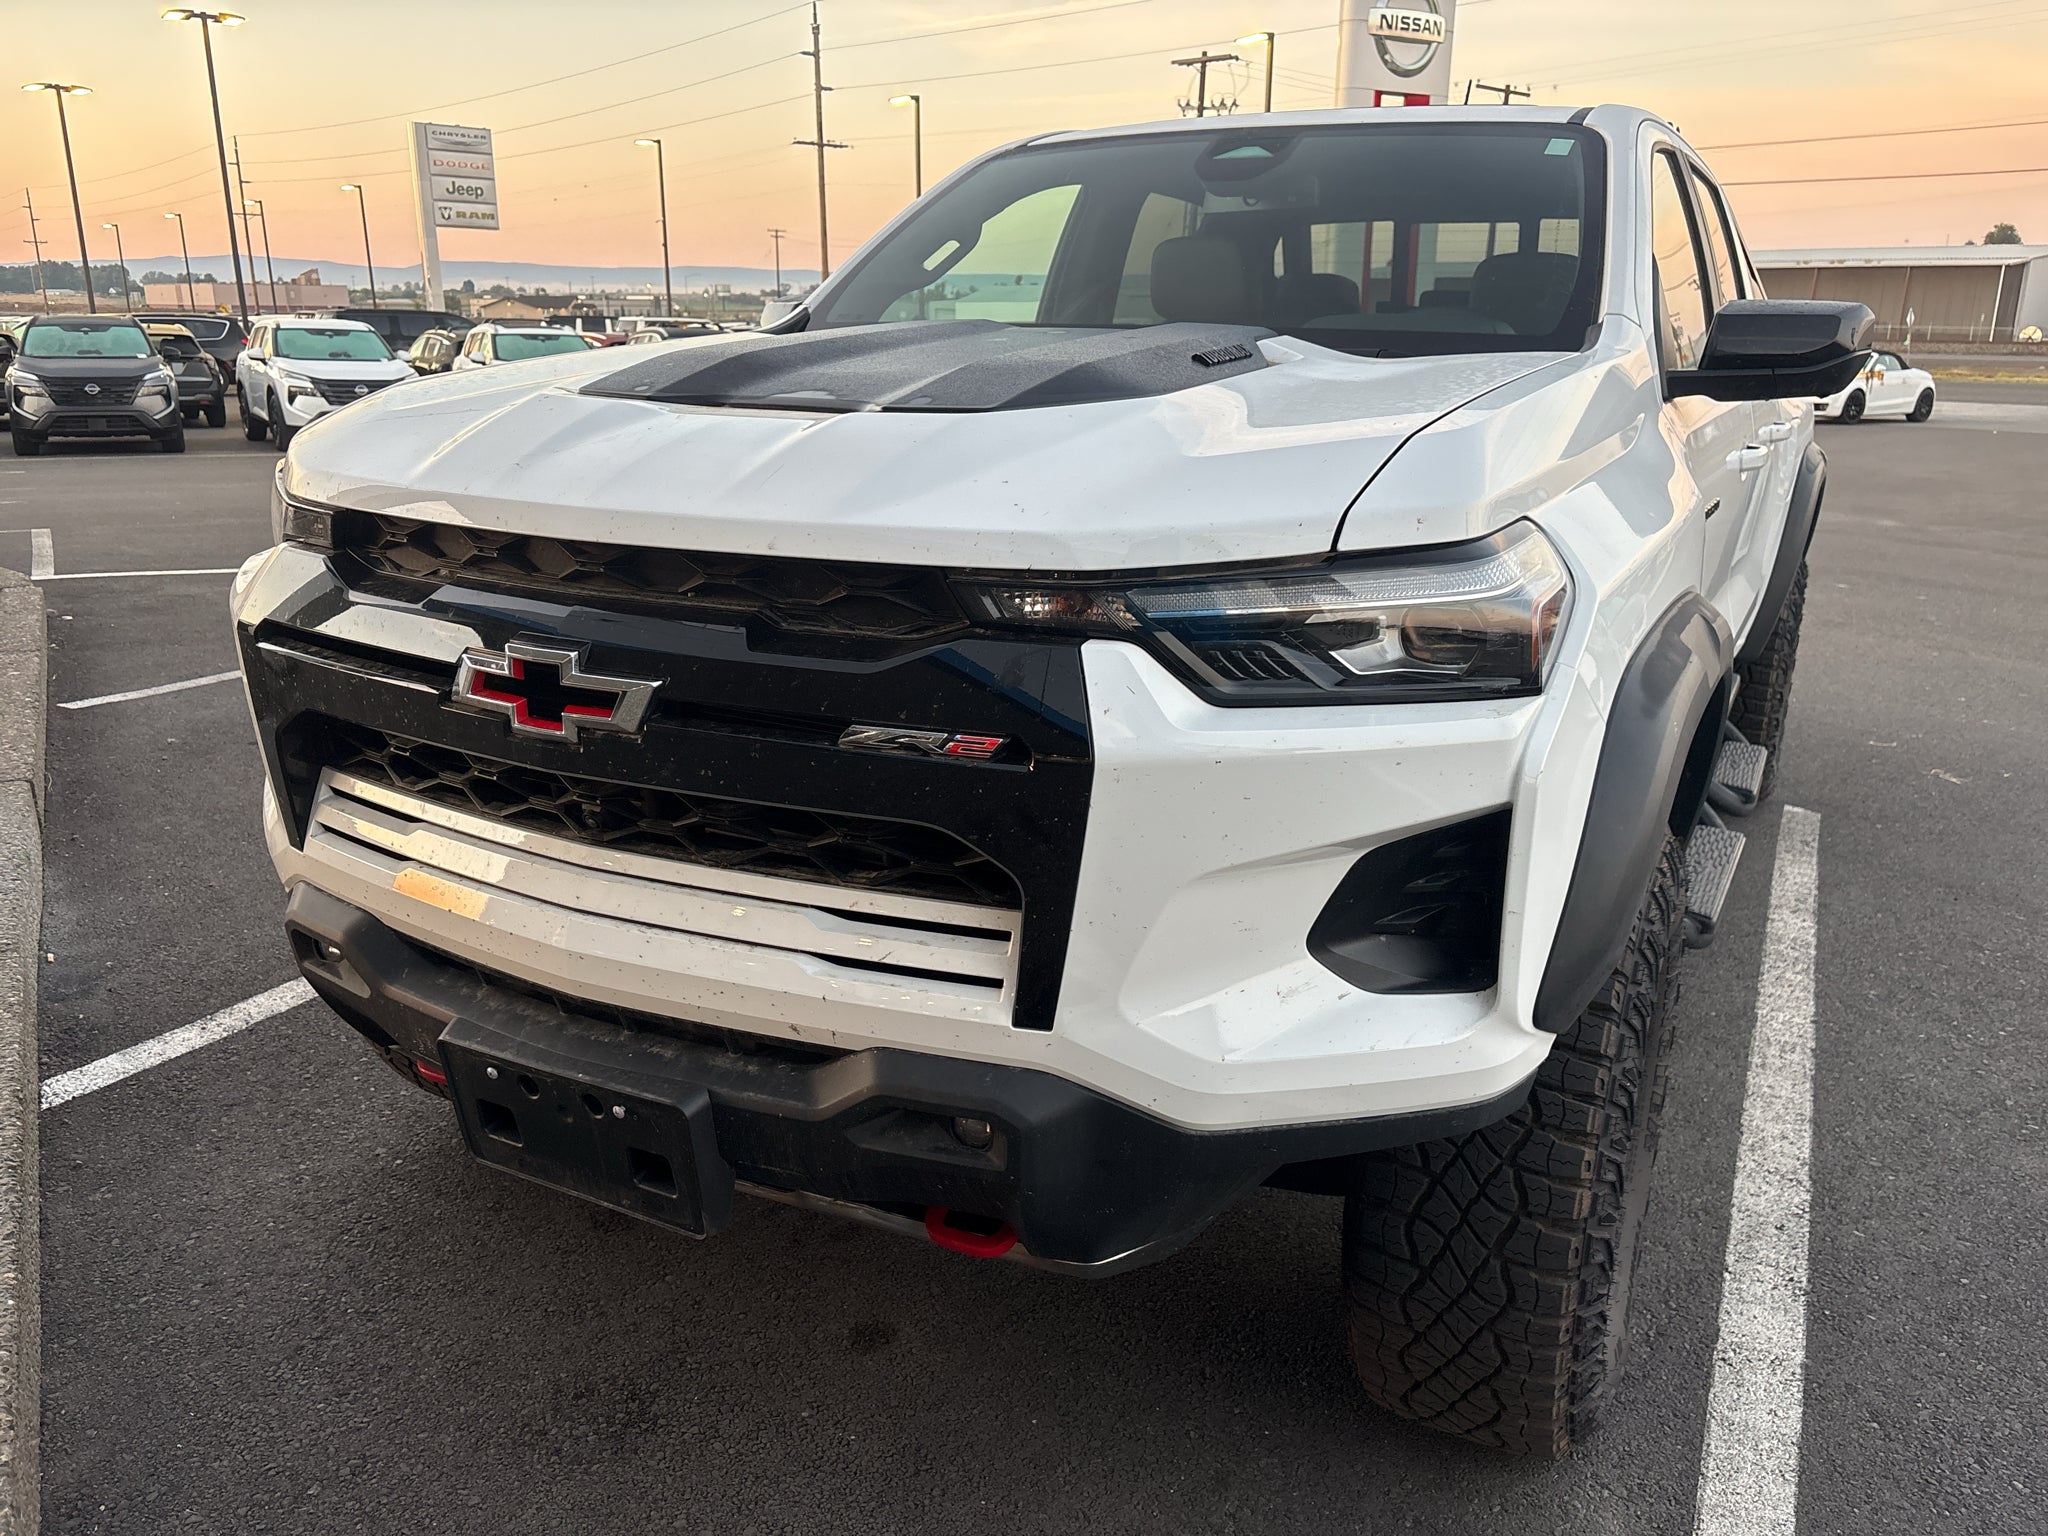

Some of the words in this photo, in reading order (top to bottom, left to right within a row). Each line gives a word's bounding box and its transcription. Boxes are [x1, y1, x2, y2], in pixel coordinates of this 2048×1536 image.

[1380, 14, 1442, 37] NISSAN
[431, 130, 487, 140] CHRYSLER
[433, 159, 491, 171] DODGE
[446, 181, 484, 199] Jeep
[456, 211, 495, 220] RAM
[838, 724, 1003, 758] ZR2
